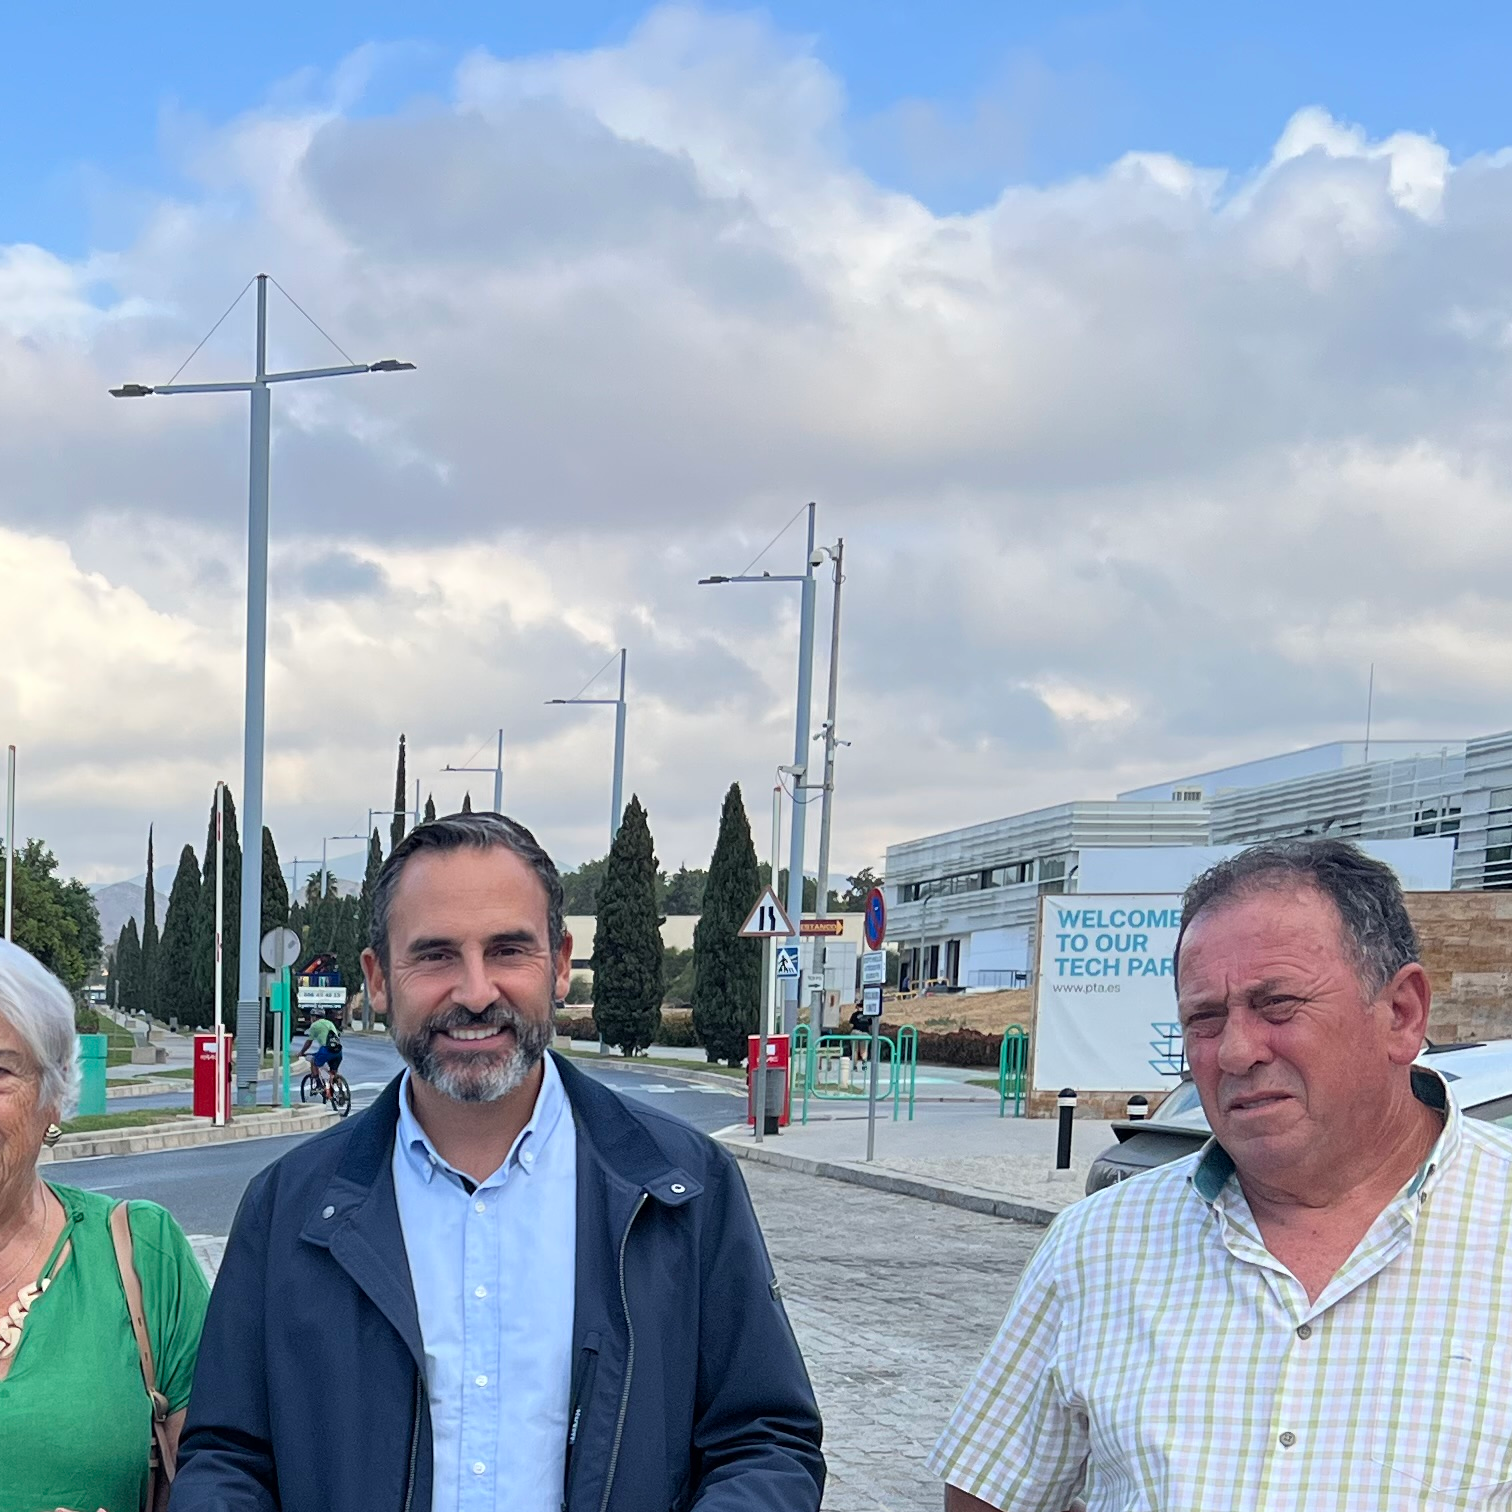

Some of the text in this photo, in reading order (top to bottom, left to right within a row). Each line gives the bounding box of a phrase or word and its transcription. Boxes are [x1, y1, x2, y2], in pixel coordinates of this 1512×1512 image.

[1057, 909, 1182, 929] WELCOME
[1055, 933, 1149, 953] TO OUR
[1054, 957, 1174, 977] TECH PAR
[1052, 982, 1121, 994] www.pta.es
